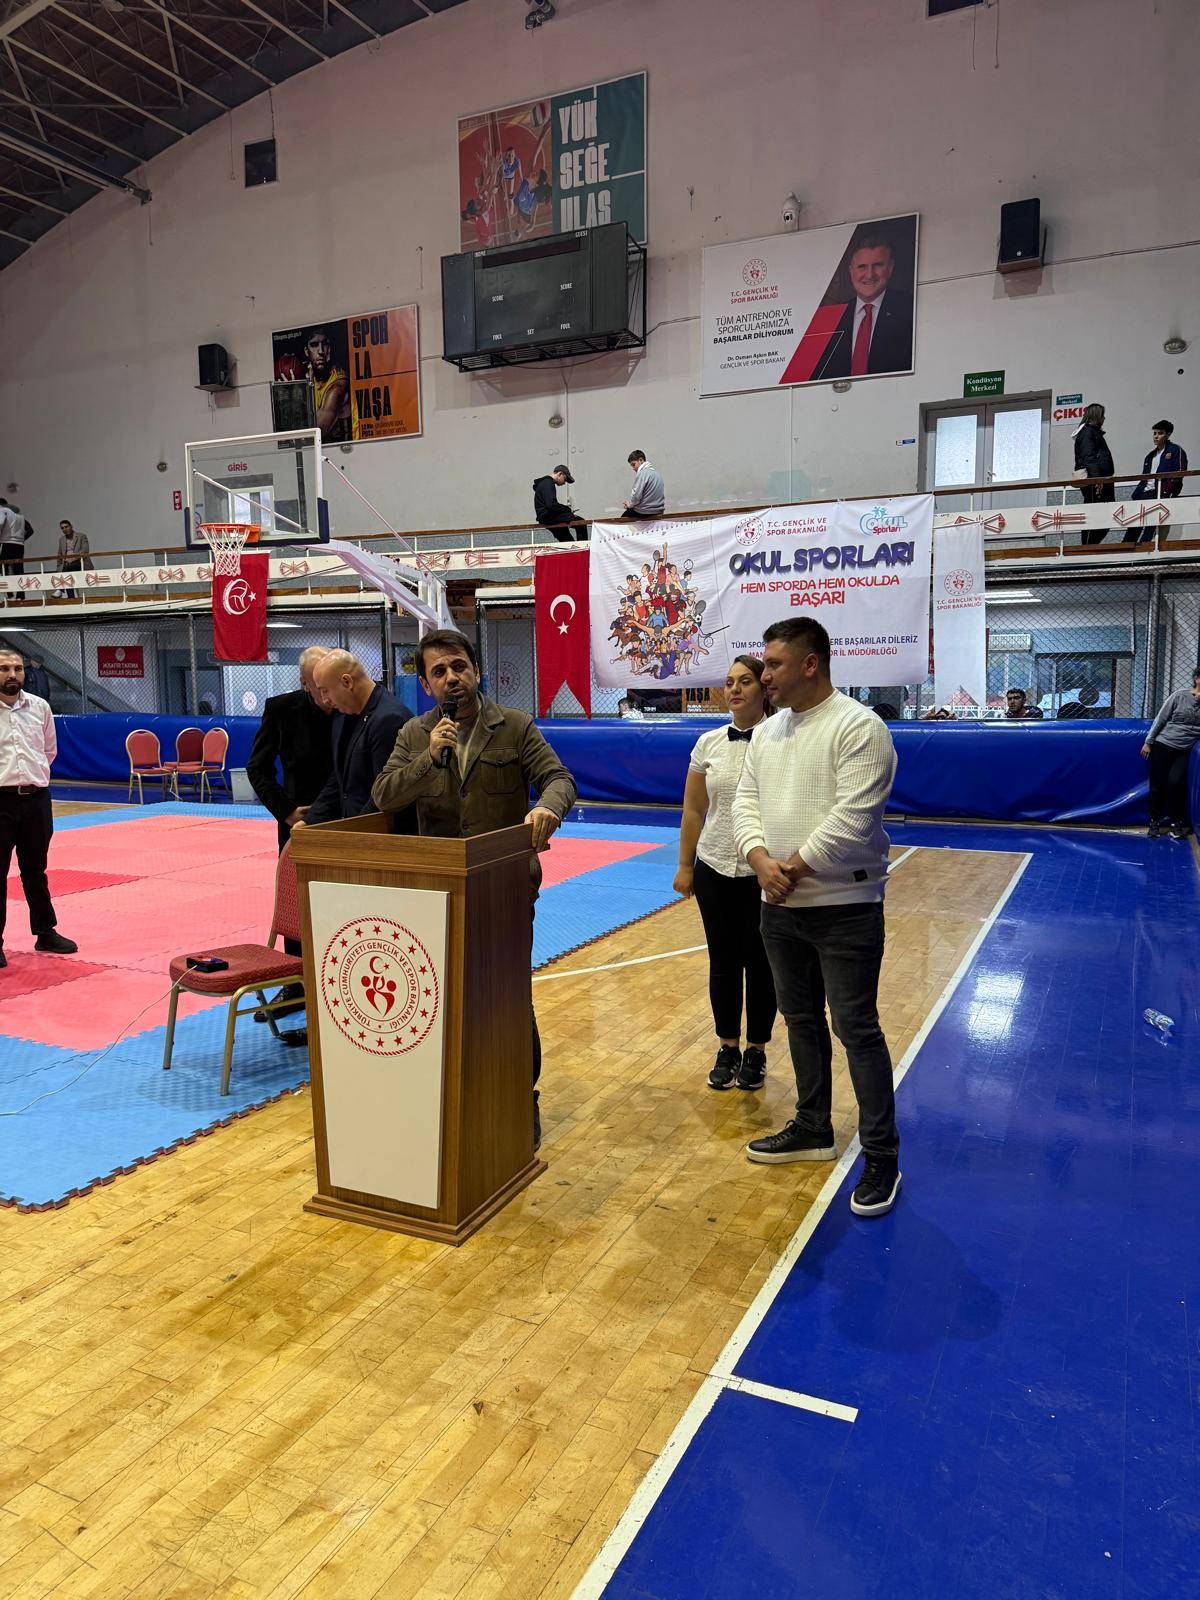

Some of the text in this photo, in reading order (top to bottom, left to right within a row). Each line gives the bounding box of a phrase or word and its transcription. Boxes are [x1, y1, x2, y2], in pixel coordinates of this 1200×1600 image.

[558, 99, 598, 145] YÜK
[716, 315, 733, 326] TÜM
[782, 308, 792, 317] VE
[352, 314, 388, 348] SPOR
[713, 334, 752, 344] BAŞARILAR
[354, 351, 373, 380] LA
[355, 386, 392, 420] YAŞA
[767, 525, 827, 536] SPOR BAKANLIĞI
[782, 518, 815, 527] GENÇLİK
[729, 541, 915, 576] OKUL SPORLARI
[741, 575, 900, 594] HEM SPORDA HEM OKULDA
[790, 591, 845, 607] BAŞARI
[731, 640, 747, 648] TÜM
[845, 637, 887, 646] BAŞARILAR
[888, 635, 918, 644] DİLERİZ
[847, 647, 898, 656] MÜDÜRLÜĞÜ
[366, 942, 399, 958] GENÇLİK
[399, 955, 408, 968] VE
[406, 967, 416, 991] SPOR
[389, 993, 417, 1029] BAKANLIĞI
